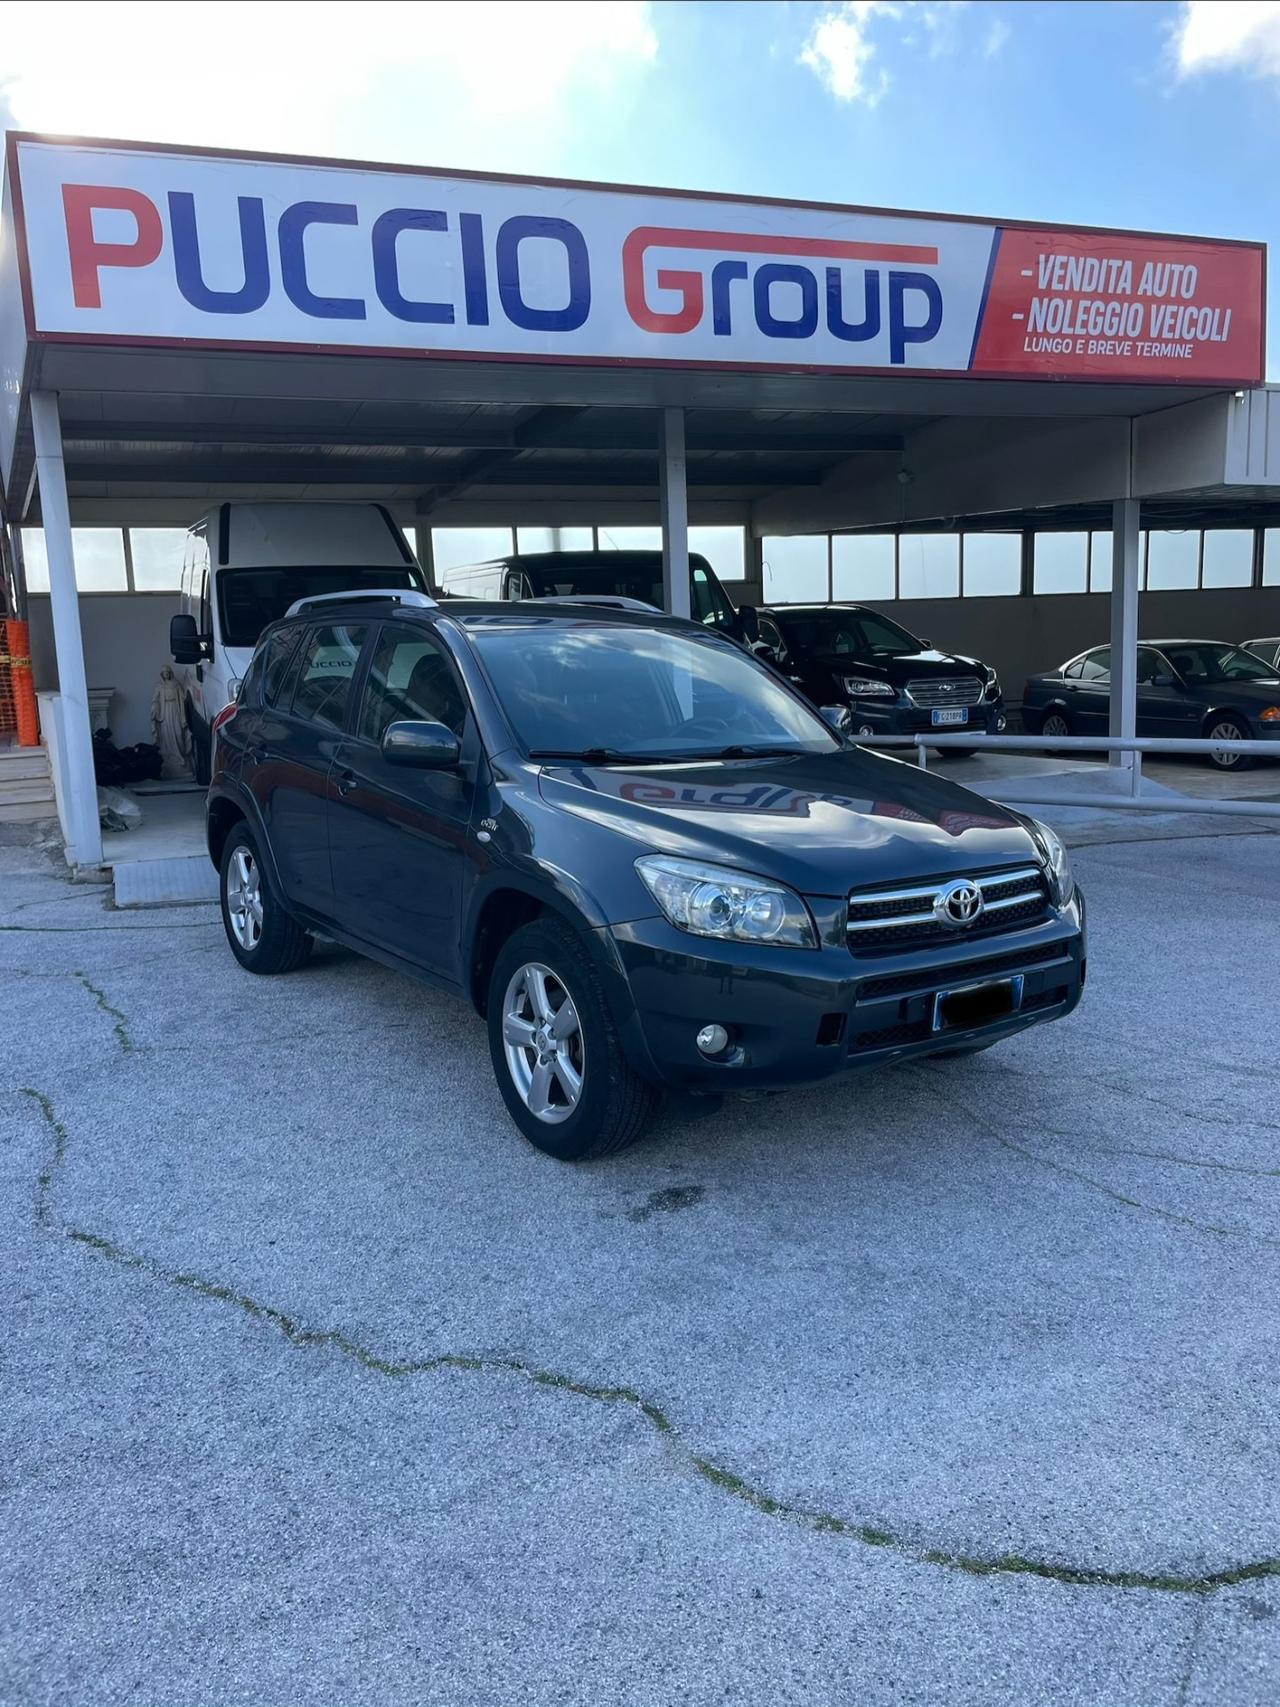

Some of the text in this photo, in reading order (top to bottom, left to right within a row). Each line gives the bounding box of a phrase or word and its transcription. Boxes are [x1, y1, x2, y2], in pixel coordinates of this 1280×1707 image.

[61, 183, 591, 332] PUCCIO
[1137, 262, 1198, 299] AUTO
[1149, 304, 1232, 342] VEICOLI
[1023, 337, 1193, 358] LUNGO E BREVE TERMINE
